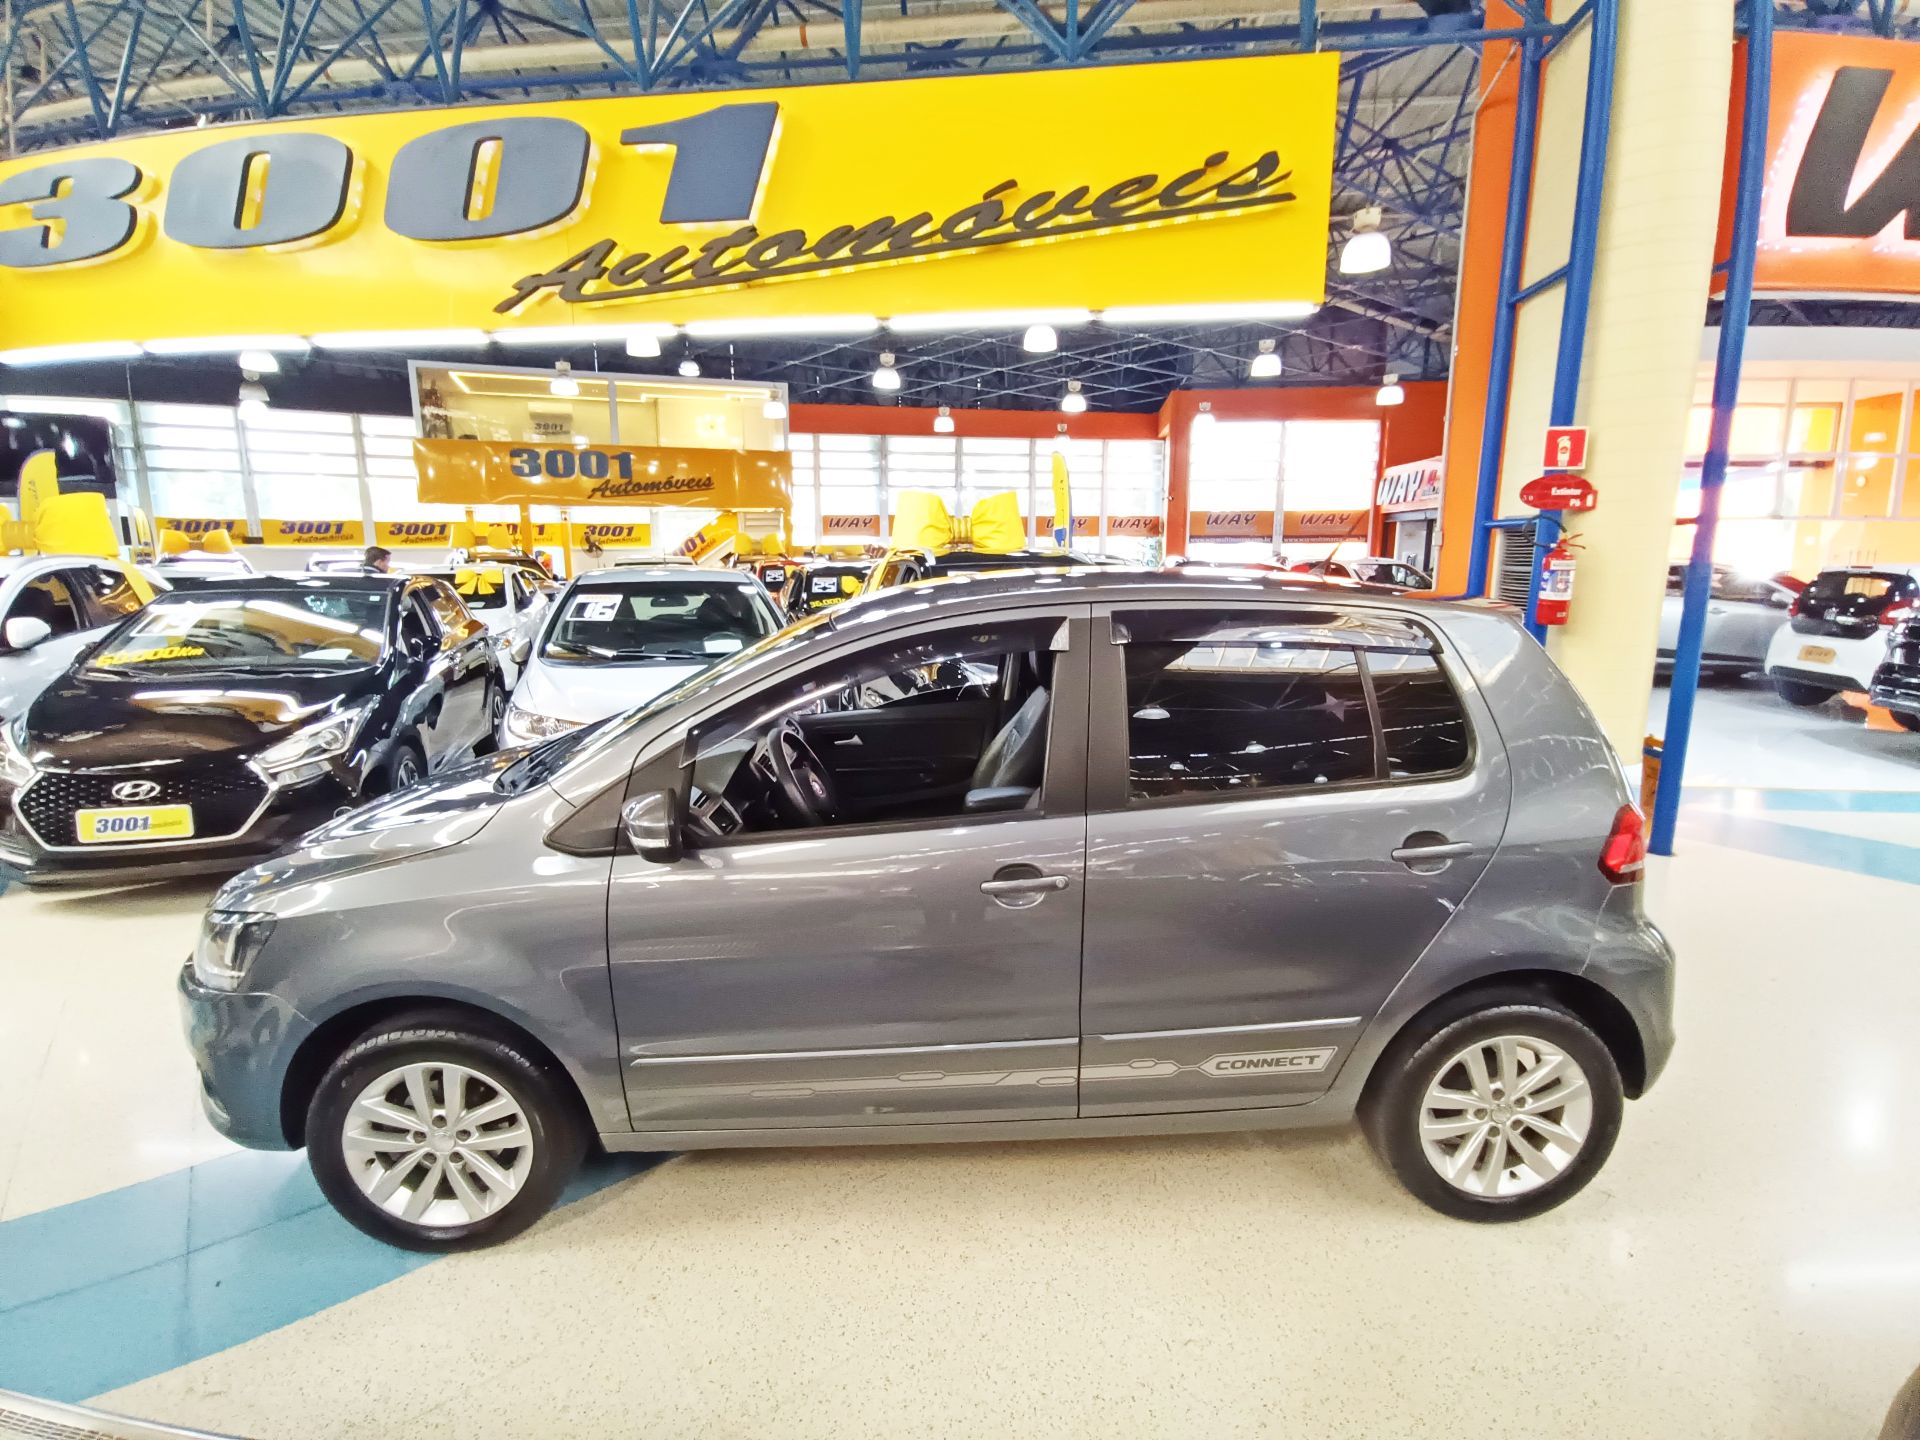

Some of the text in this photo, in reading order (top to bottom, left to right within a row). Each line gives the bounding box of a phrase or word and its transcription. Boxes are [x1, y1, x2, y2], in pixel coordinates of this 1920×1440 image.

[0, 101, 780, 268] 3001
[493, 150, 1295, 314] Automóveis
[510, 448, 633, 480] 3001
[587, 475, 715, 499] Automóveis
[1379, 469, 1425, 505] WAY
[1551, 487, 1582, 496] Extintor
[829, 517, 873, 528] WAY
[1112, 518, 1153, 529] WAY
[1206, 513, 1257, 526] WAY
[1300, 513, 1350, 526] WAY
[279, 521, 345, 534] 3001
[389, 523, 447, 535] 3001
[585, 525, 635, 537] 3001
[96, 816, 150, 833] 3001
[1215, 1055, 1320, 1071] CONNECT
